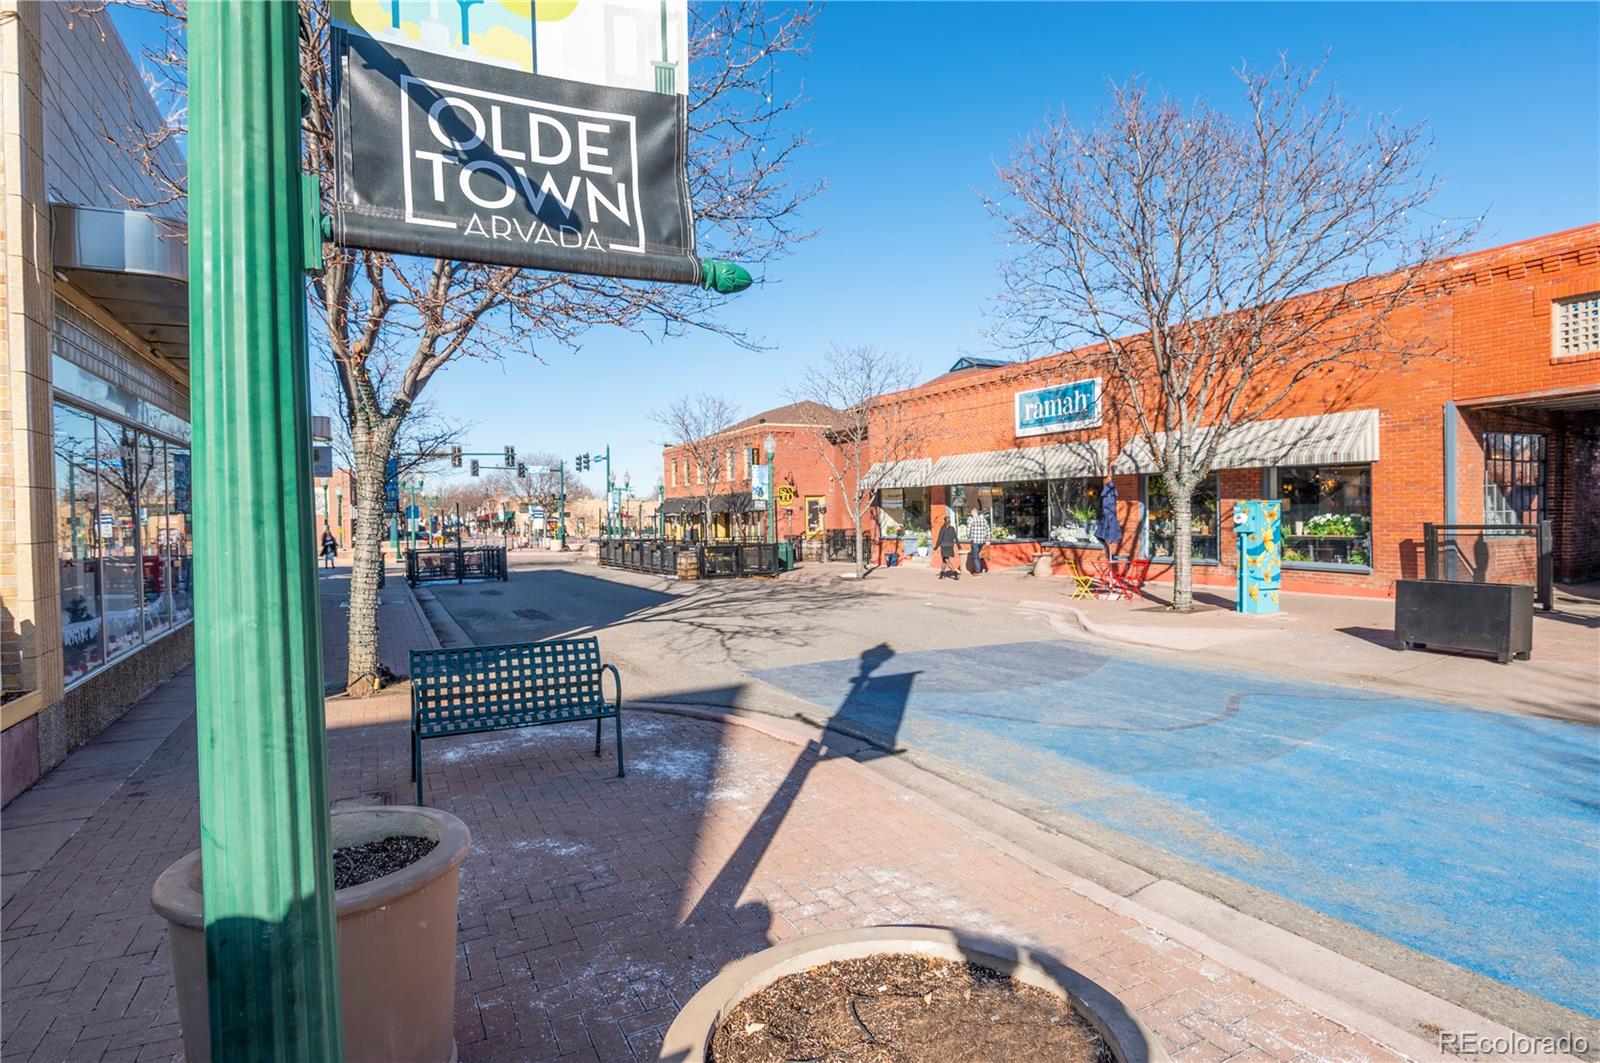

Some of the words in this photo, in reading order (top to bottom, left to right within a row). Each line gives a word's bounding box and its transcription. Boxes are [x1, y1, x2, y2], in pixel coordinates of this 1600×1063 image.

[427, 95, 613, 175] OLDE
[415, 150, 631, 227] TOWN
[464, 212, 608, 252] ARVADA
[1024, 390, 1088, 421] ramah
